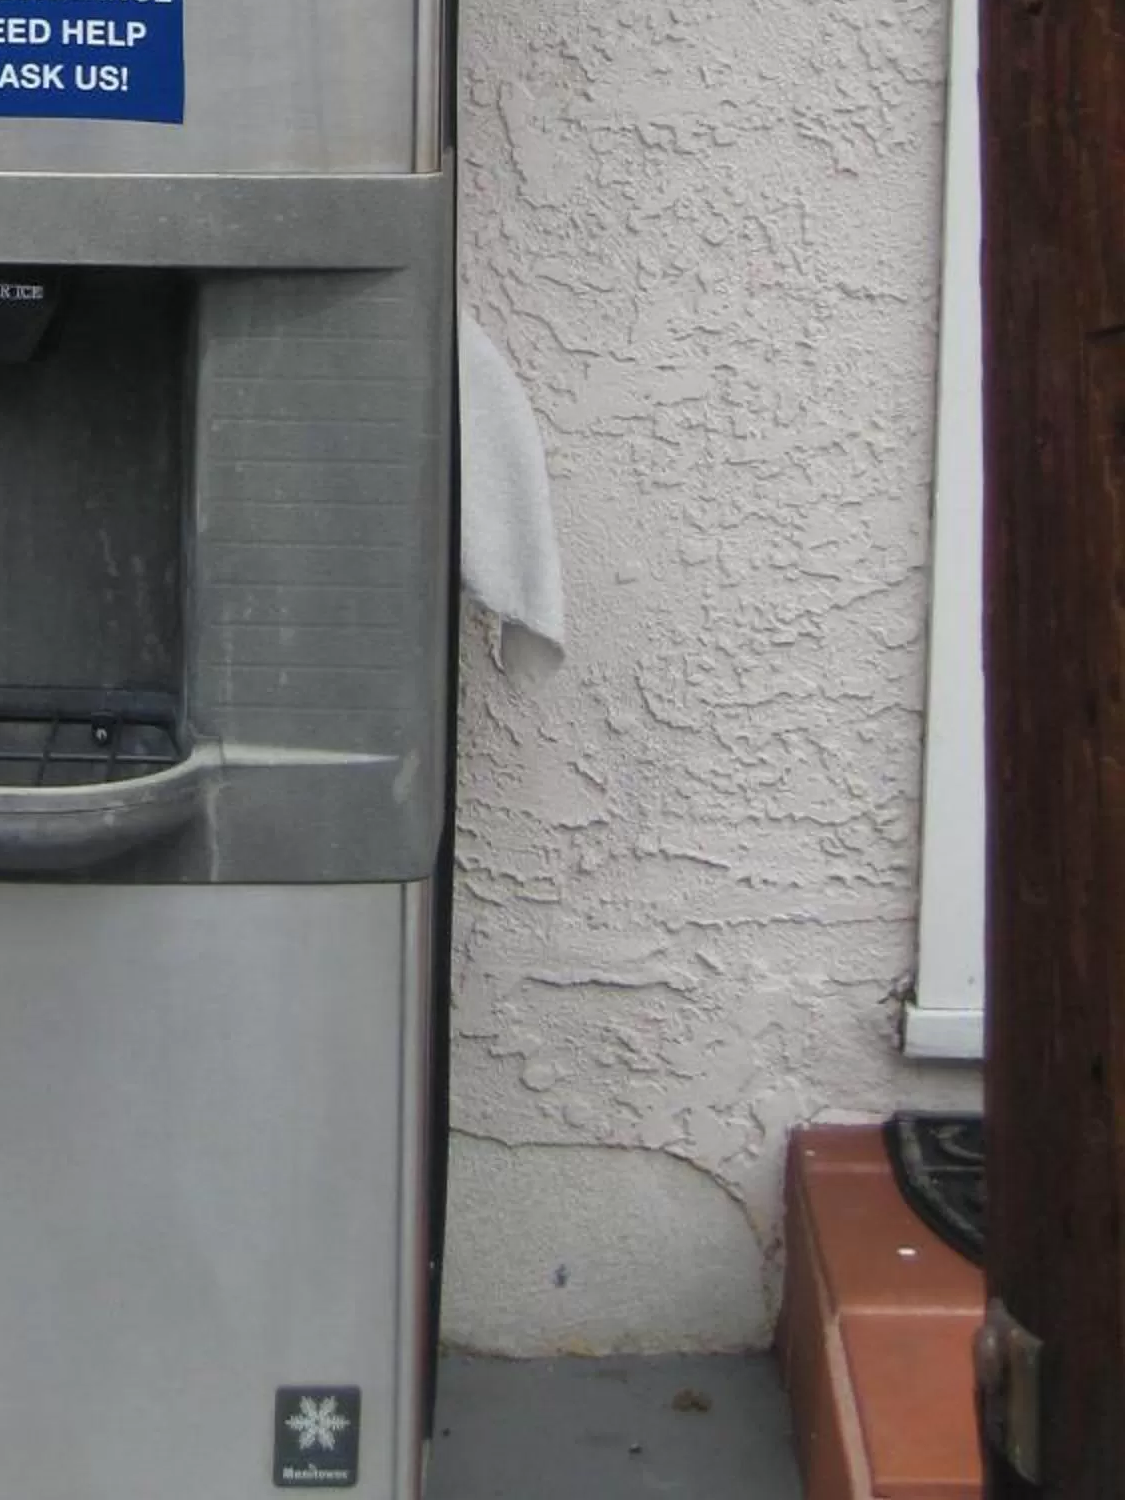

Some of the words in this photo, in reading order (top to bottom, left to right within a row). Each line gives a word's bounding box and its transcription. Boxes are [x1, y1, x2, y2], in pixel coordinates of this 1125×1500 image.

[61, 19, 147, 47] HELP
[75, 65, 129, 91] US!
[16, 284, 44, 300] ICE
